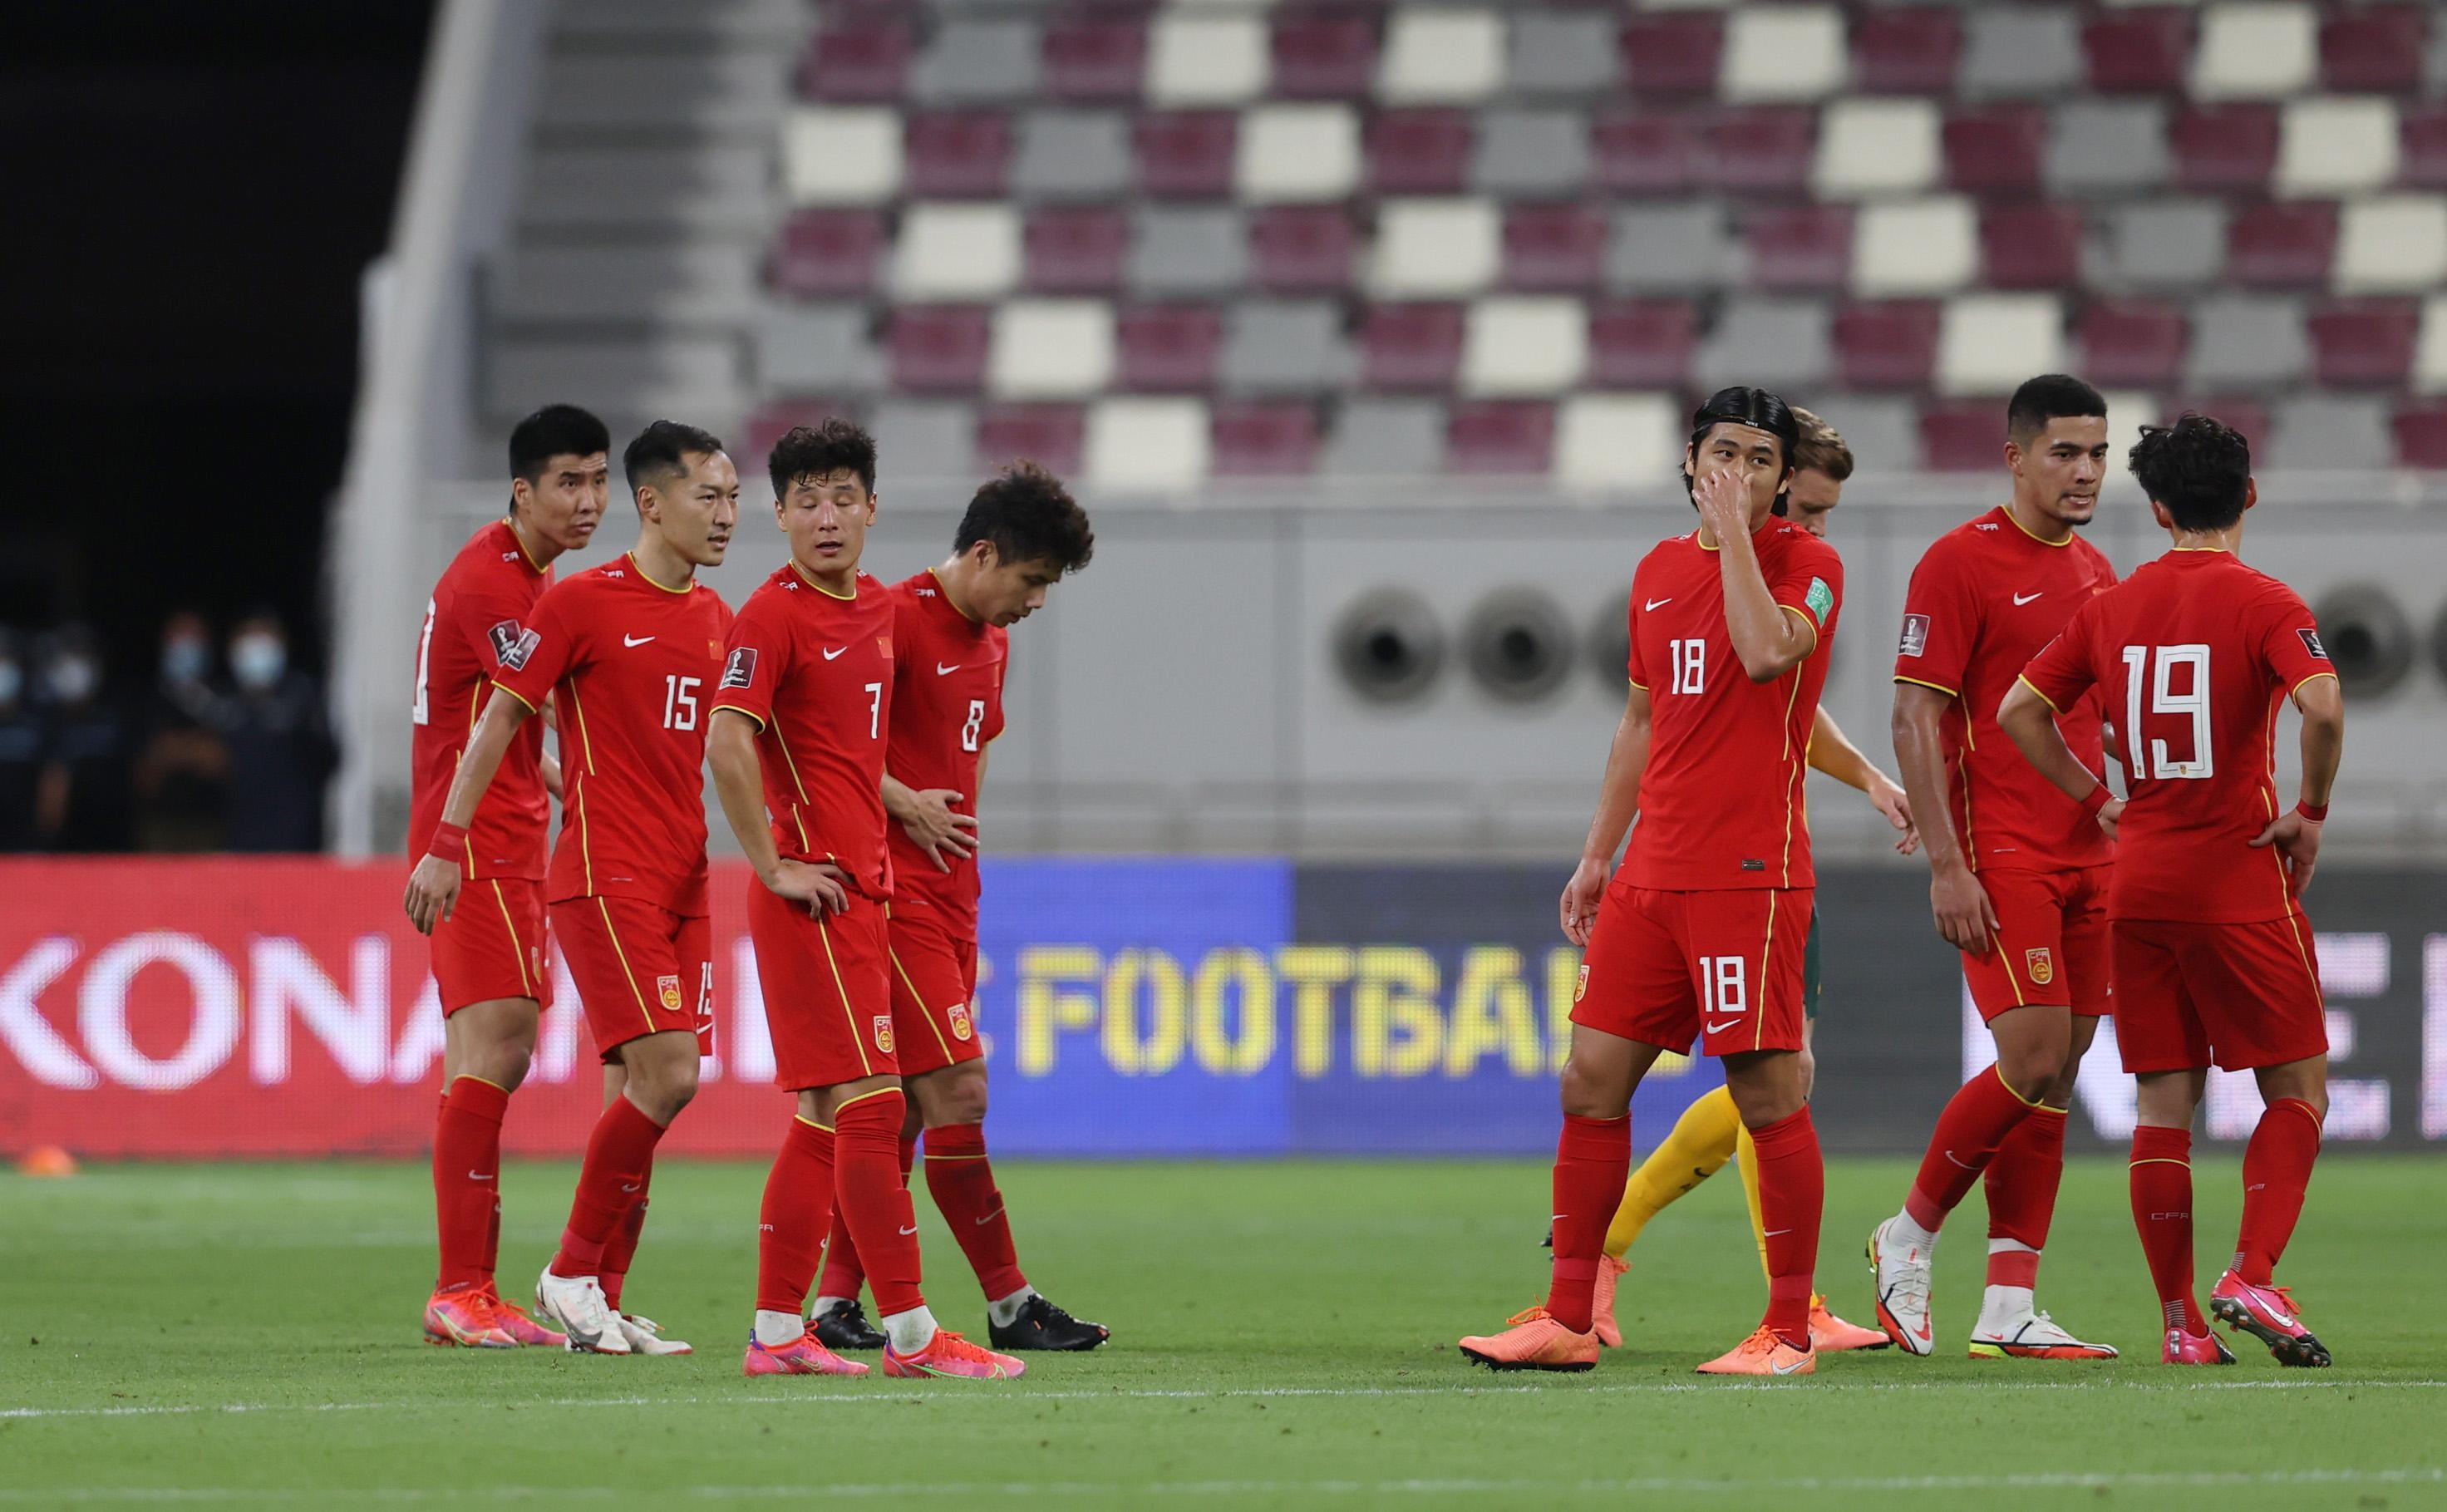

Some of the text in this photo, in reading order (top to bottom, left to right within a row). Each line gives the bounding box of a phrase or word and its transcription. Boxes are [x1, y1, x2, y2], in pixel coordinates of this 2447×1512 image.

[1669, 638, 1706, 695] 18
[664, 675, 702, 731] 15
[864, 682, 882, 739] 7
[962, 700, 985, 751] 8
[2122, 643, 2213, 780] 19
[1700, 956, 1746, 1012] 18
[2151, 1212, 2189, 1220] CFA
